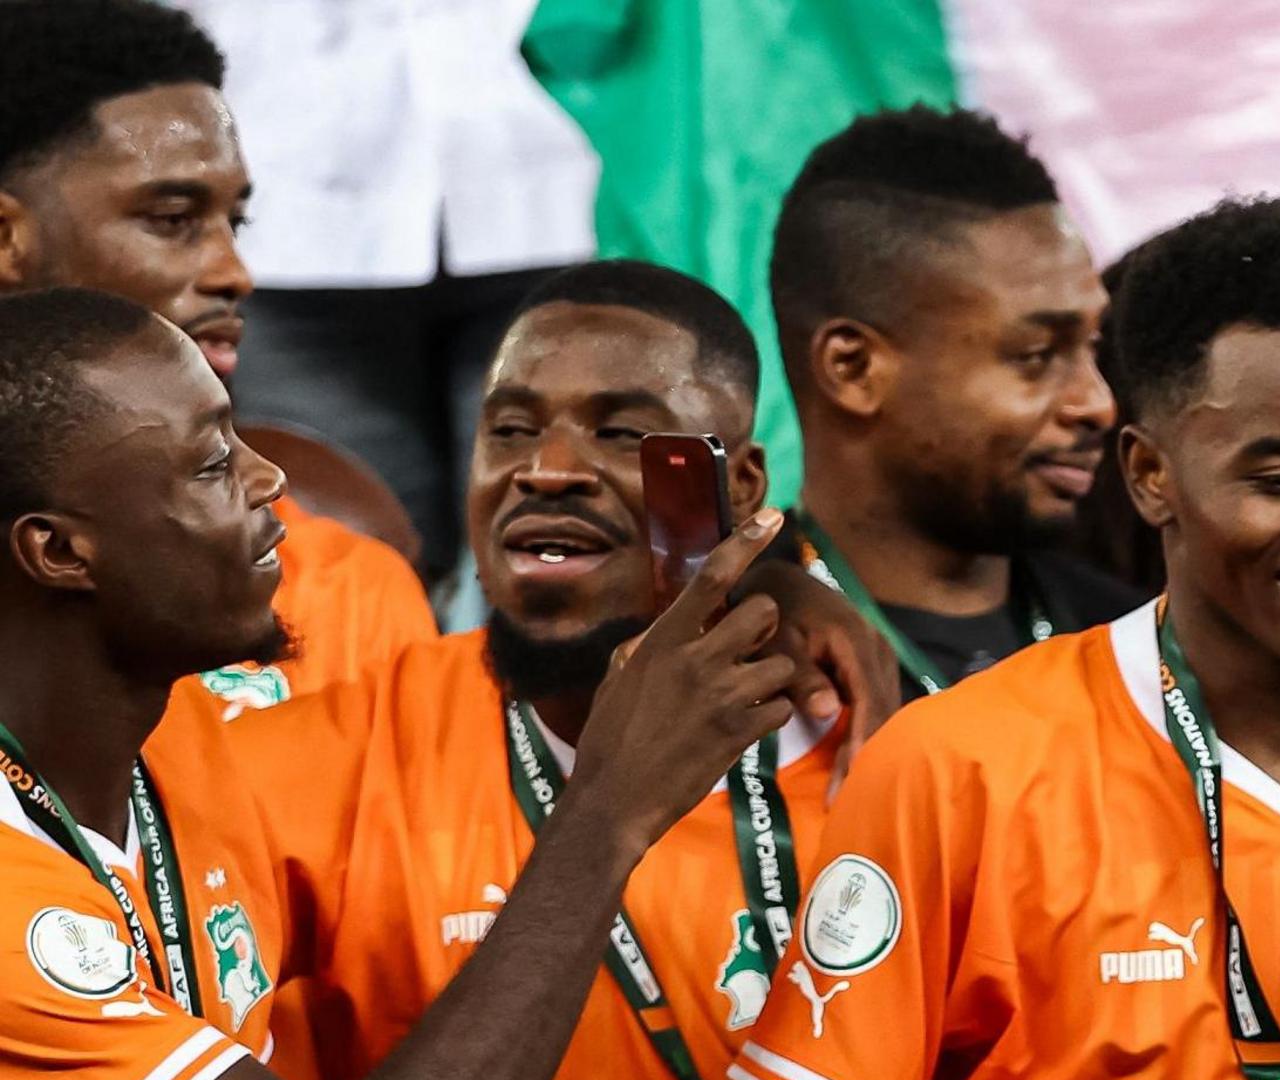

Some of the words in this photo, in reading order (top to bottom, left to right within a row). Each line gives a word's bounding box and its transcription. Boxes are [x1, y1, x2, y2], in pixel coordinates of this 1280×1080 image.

[1164, 687, 1213, 768] NATIONS
[749, 795, 772, 832] CUP
[148, 832, 165, 867] CUP
[754, 829, 784, 904] AFRICA
[154, 865, 180, 940] AFRICA
[1100, 947, 1186, 984] PUMA
